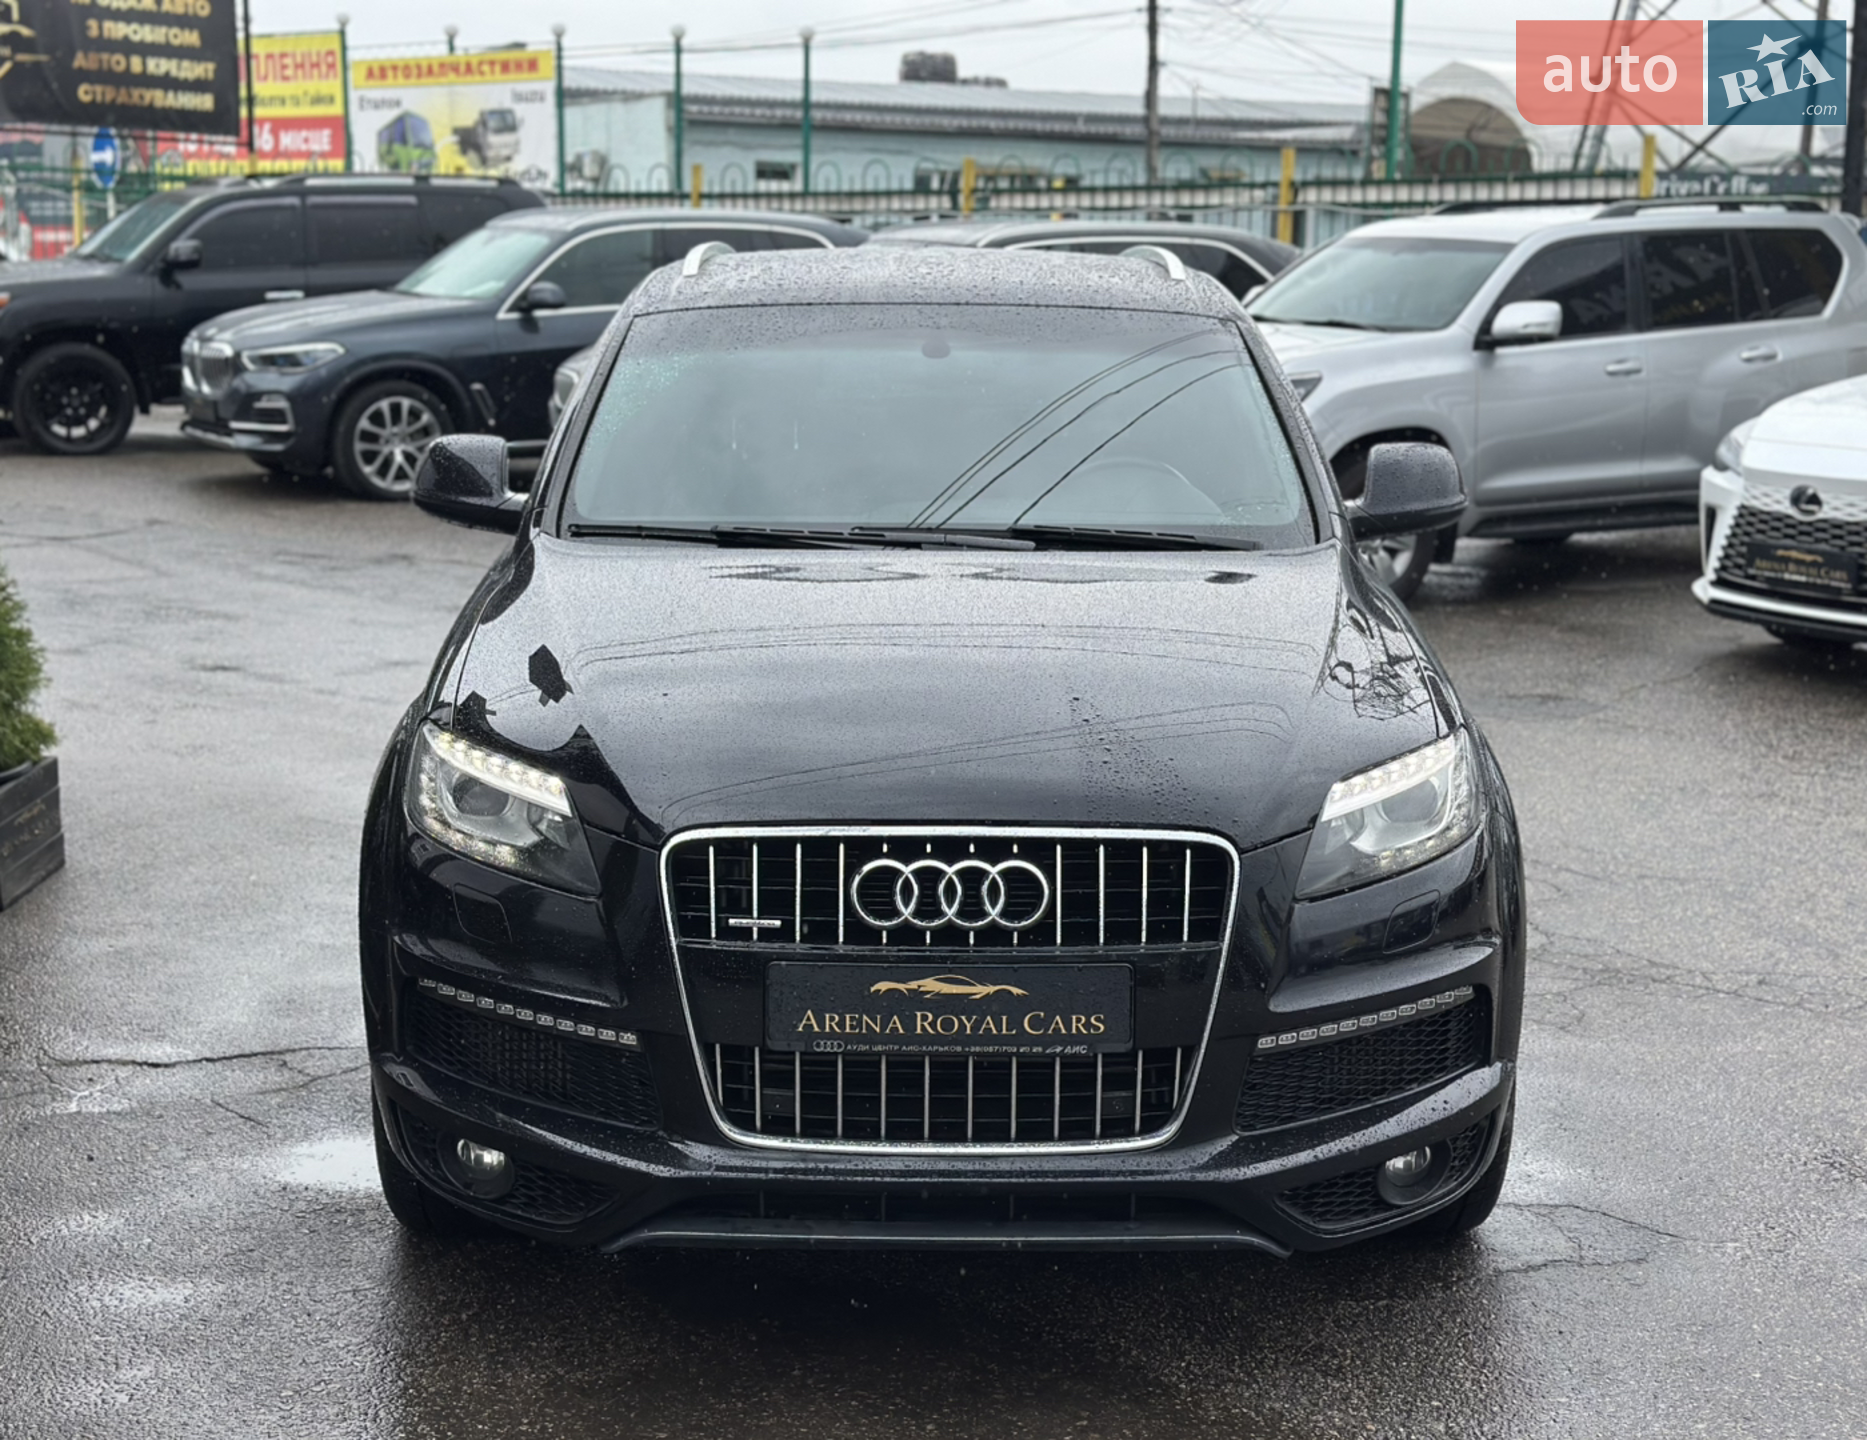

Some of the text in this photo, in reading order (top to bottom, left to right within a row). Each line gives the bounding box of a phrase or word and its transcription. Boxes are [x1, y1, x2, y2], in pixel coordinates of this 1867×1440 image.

[102, 19, 202, 48] ПРОБІГОМ
[72, 51, 217, 82] АВТО В КРЕДИТ
[364, 57, 540, 82] АВТОЗАПЧАСТИНИ
[77, 82, 215, 112] СТРАХУВАННЯ
